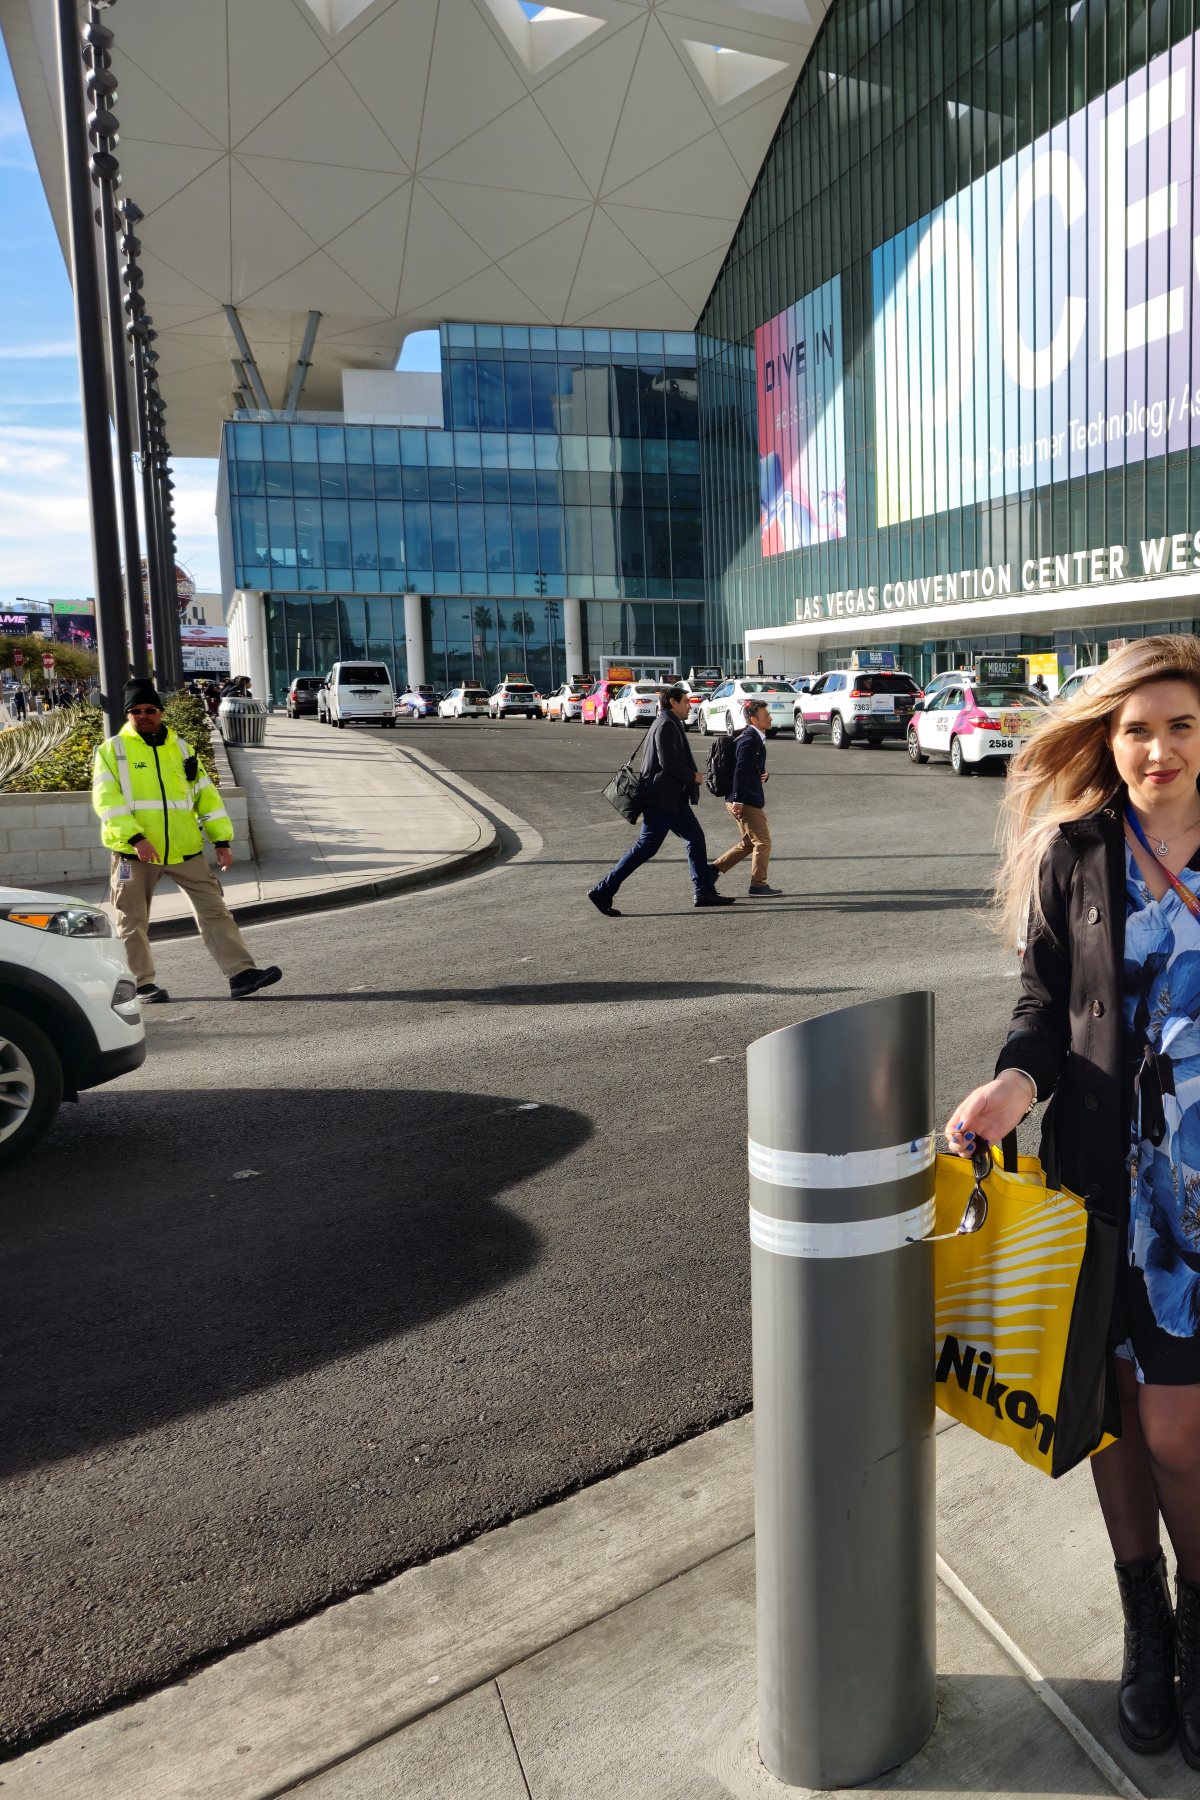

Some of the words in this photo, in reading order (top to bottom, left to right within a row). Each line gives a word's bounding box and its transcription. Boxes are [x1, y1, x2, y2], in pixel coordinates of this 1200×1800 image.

[765, 340, 806, 392] DIVE
[815, 324, 834, 365] IN
[989, 430, 1065, 478] Consumer
[1069, 394, 1176, 453] Technology
[795, 595, 821, 621] LAS
[827, 586, 877, 617] VEGAS
[882, 563, 1012, 610] CONVENTION
[1021, 545, 1128, 591] CENTER
[988, 662, 1012, 673] MIRACLE
[854, 703, 870, 711] 7363
[988, 740, 1014, 748] 2588
[935, 1334, 1055, 1455] Nikon
